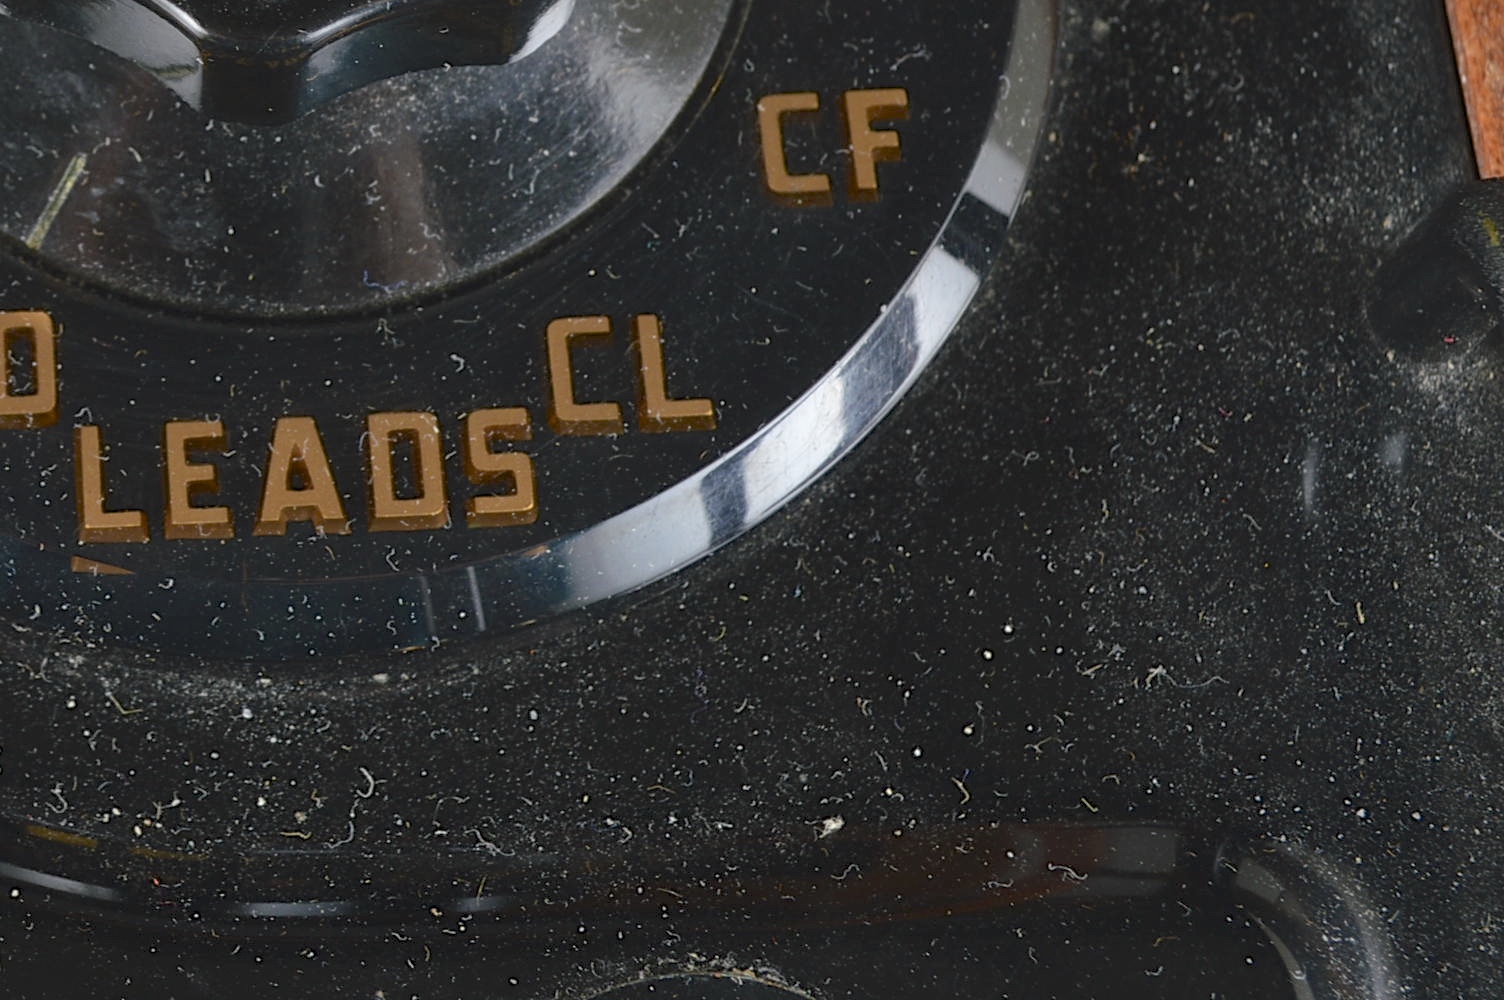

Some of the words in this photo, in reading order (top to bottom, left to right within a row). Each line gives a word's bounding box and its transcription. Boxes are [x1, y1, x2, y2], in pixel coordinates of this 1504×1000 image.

[757, 89, 910, 202] CF
[546, 312, 715, 434] CL
[76, 406, 539, 544] LEADS
